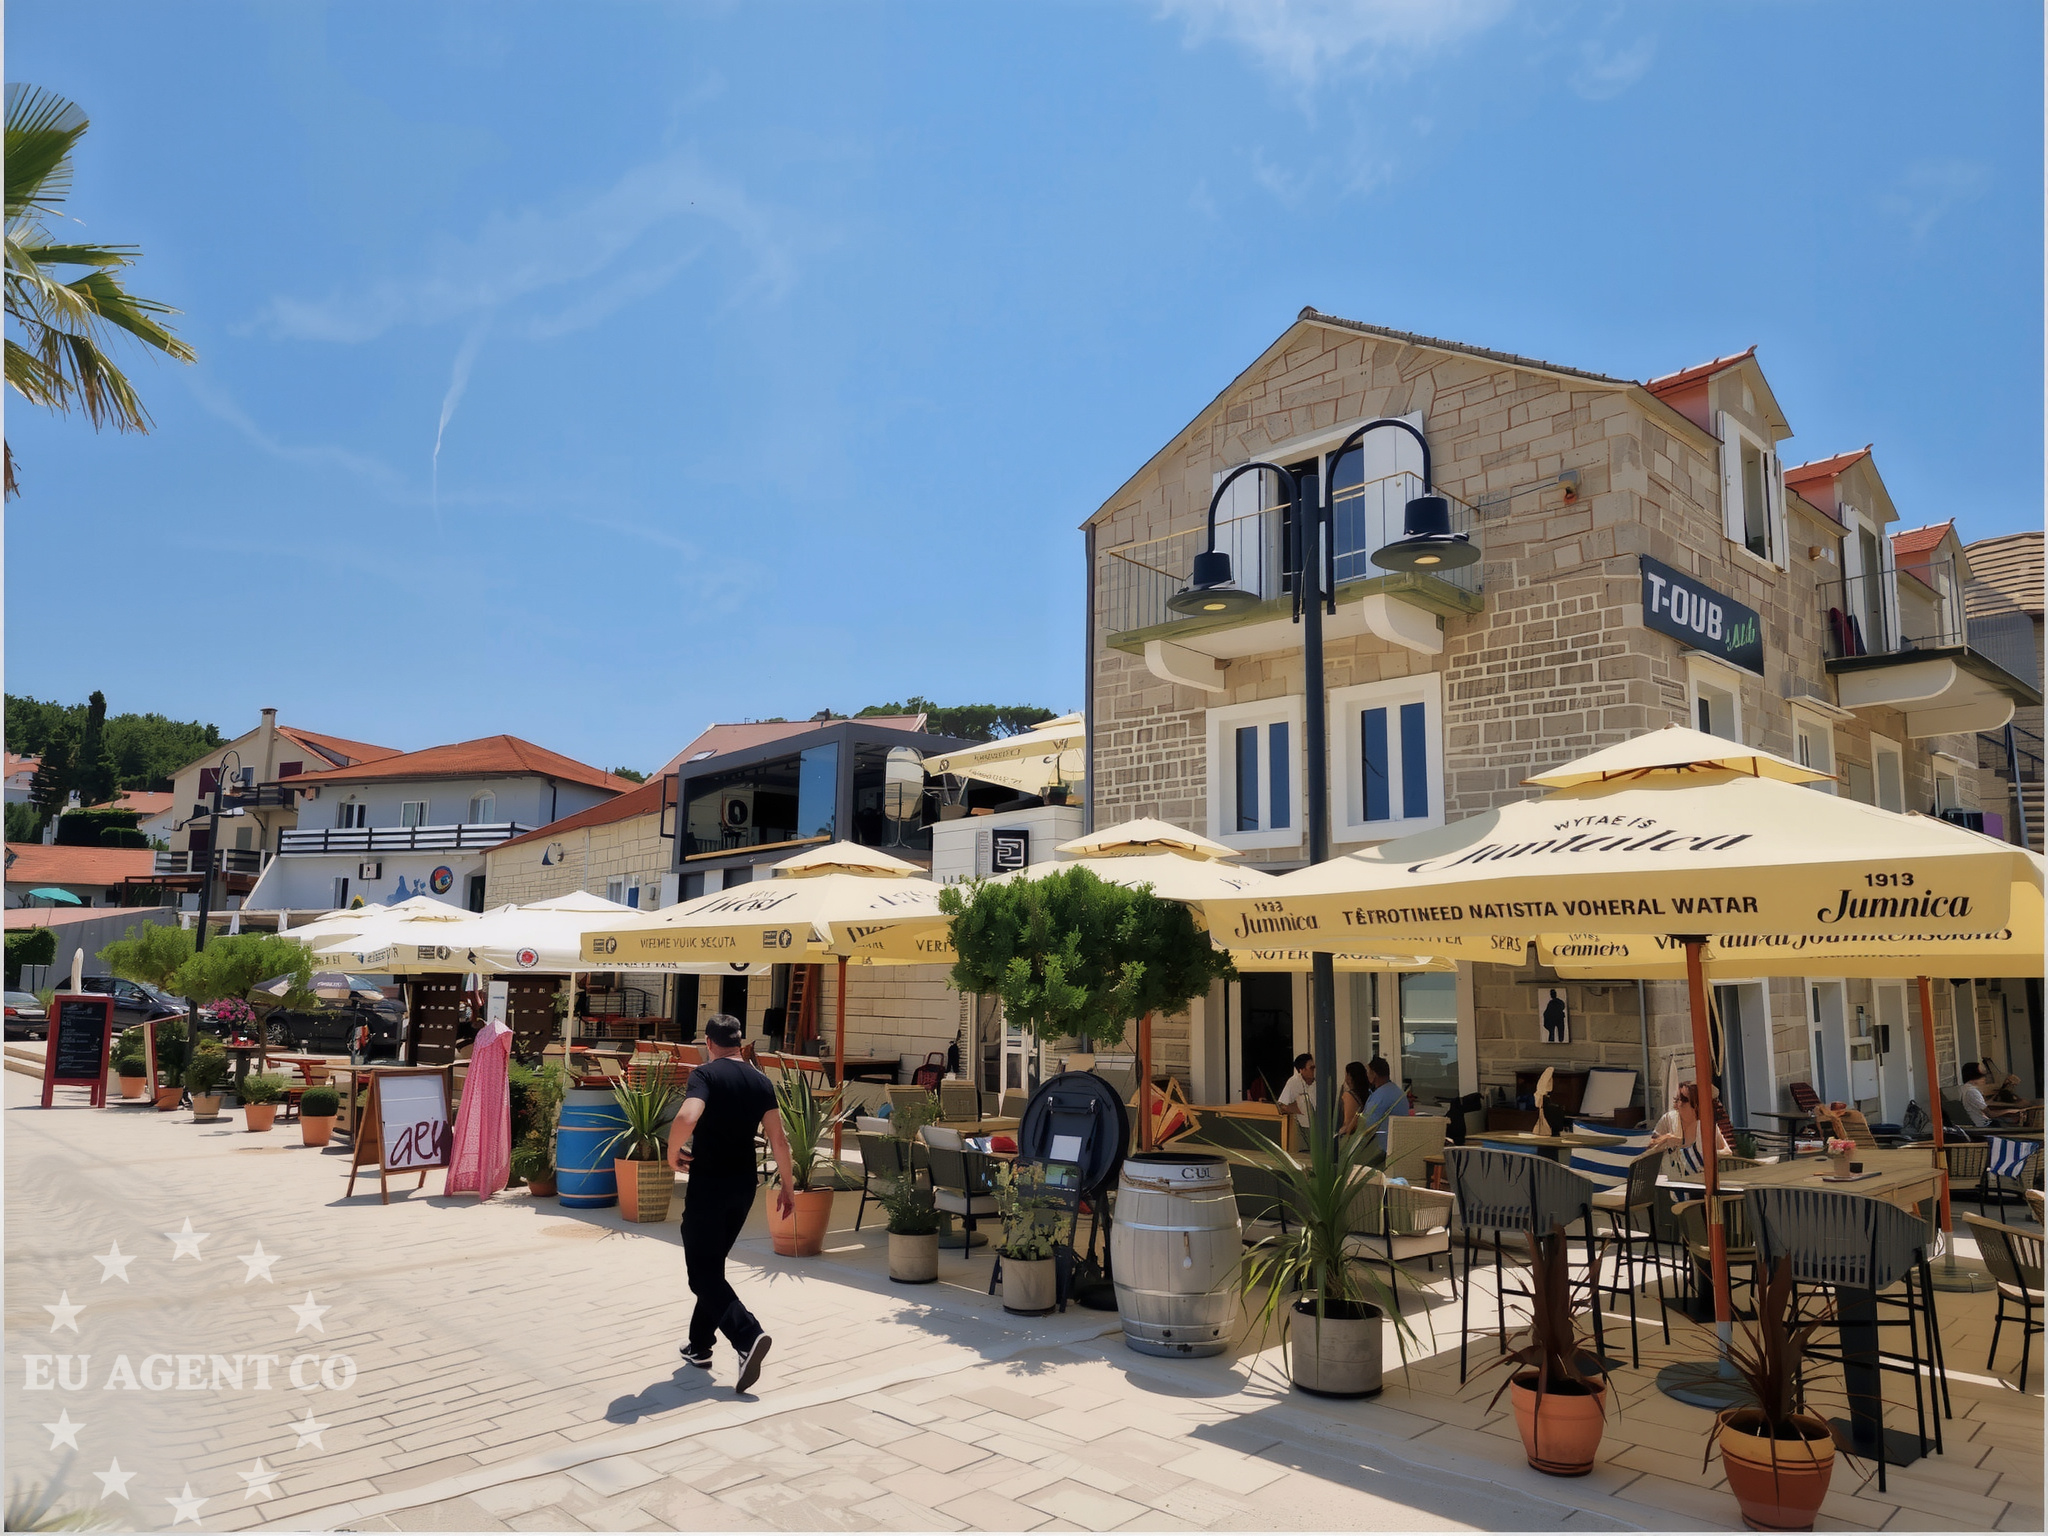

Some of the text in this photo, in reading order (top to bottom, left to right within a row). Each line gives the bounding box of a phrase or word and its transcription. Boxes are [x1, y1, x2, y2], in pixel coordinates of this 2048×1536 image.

[1648, 572, 1723, 640] T-OUB
[1864, 872, 1915, 887] 1913
[1562, 899, 1666, 917] VOHERAL
[1672, 896, 1759, 914] WATAR
[1816, 889, 1973, 923] Jumnica
